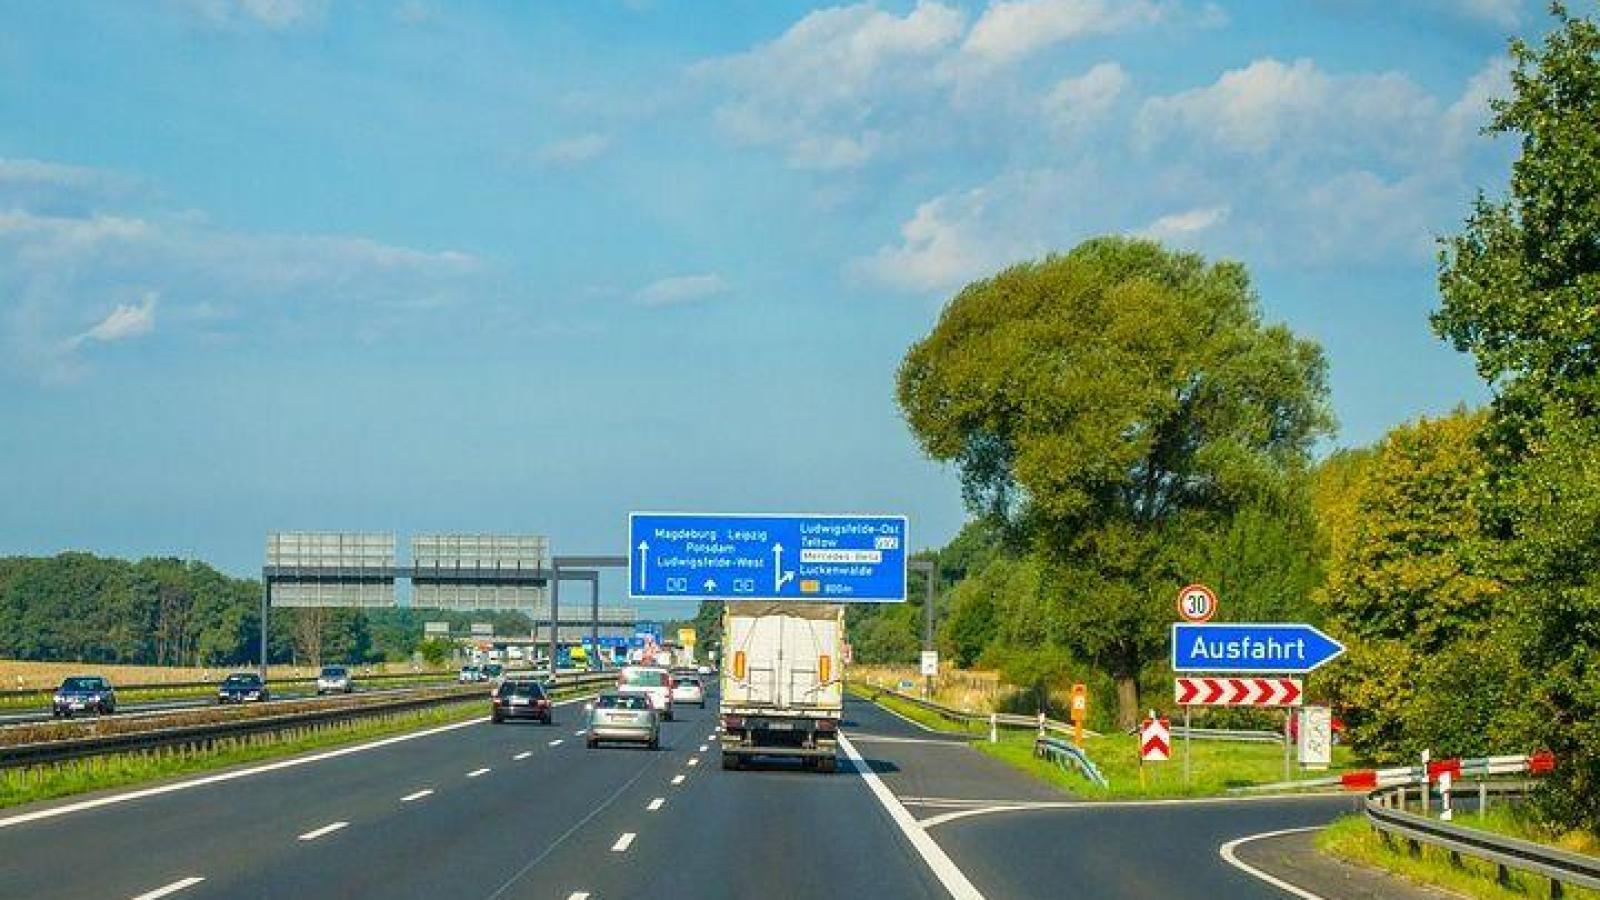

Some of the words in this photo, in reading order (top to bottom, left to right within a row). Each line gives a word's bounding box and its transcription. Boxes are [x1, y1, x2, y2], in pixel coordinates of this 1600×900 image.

[655, 528, 716, 543] Magdeburg
[728, 528, 768, 543] Leipzig
[1188, 595, 1206, 614] 30
[1190, 636, 1305, 659] Ausfahrt
